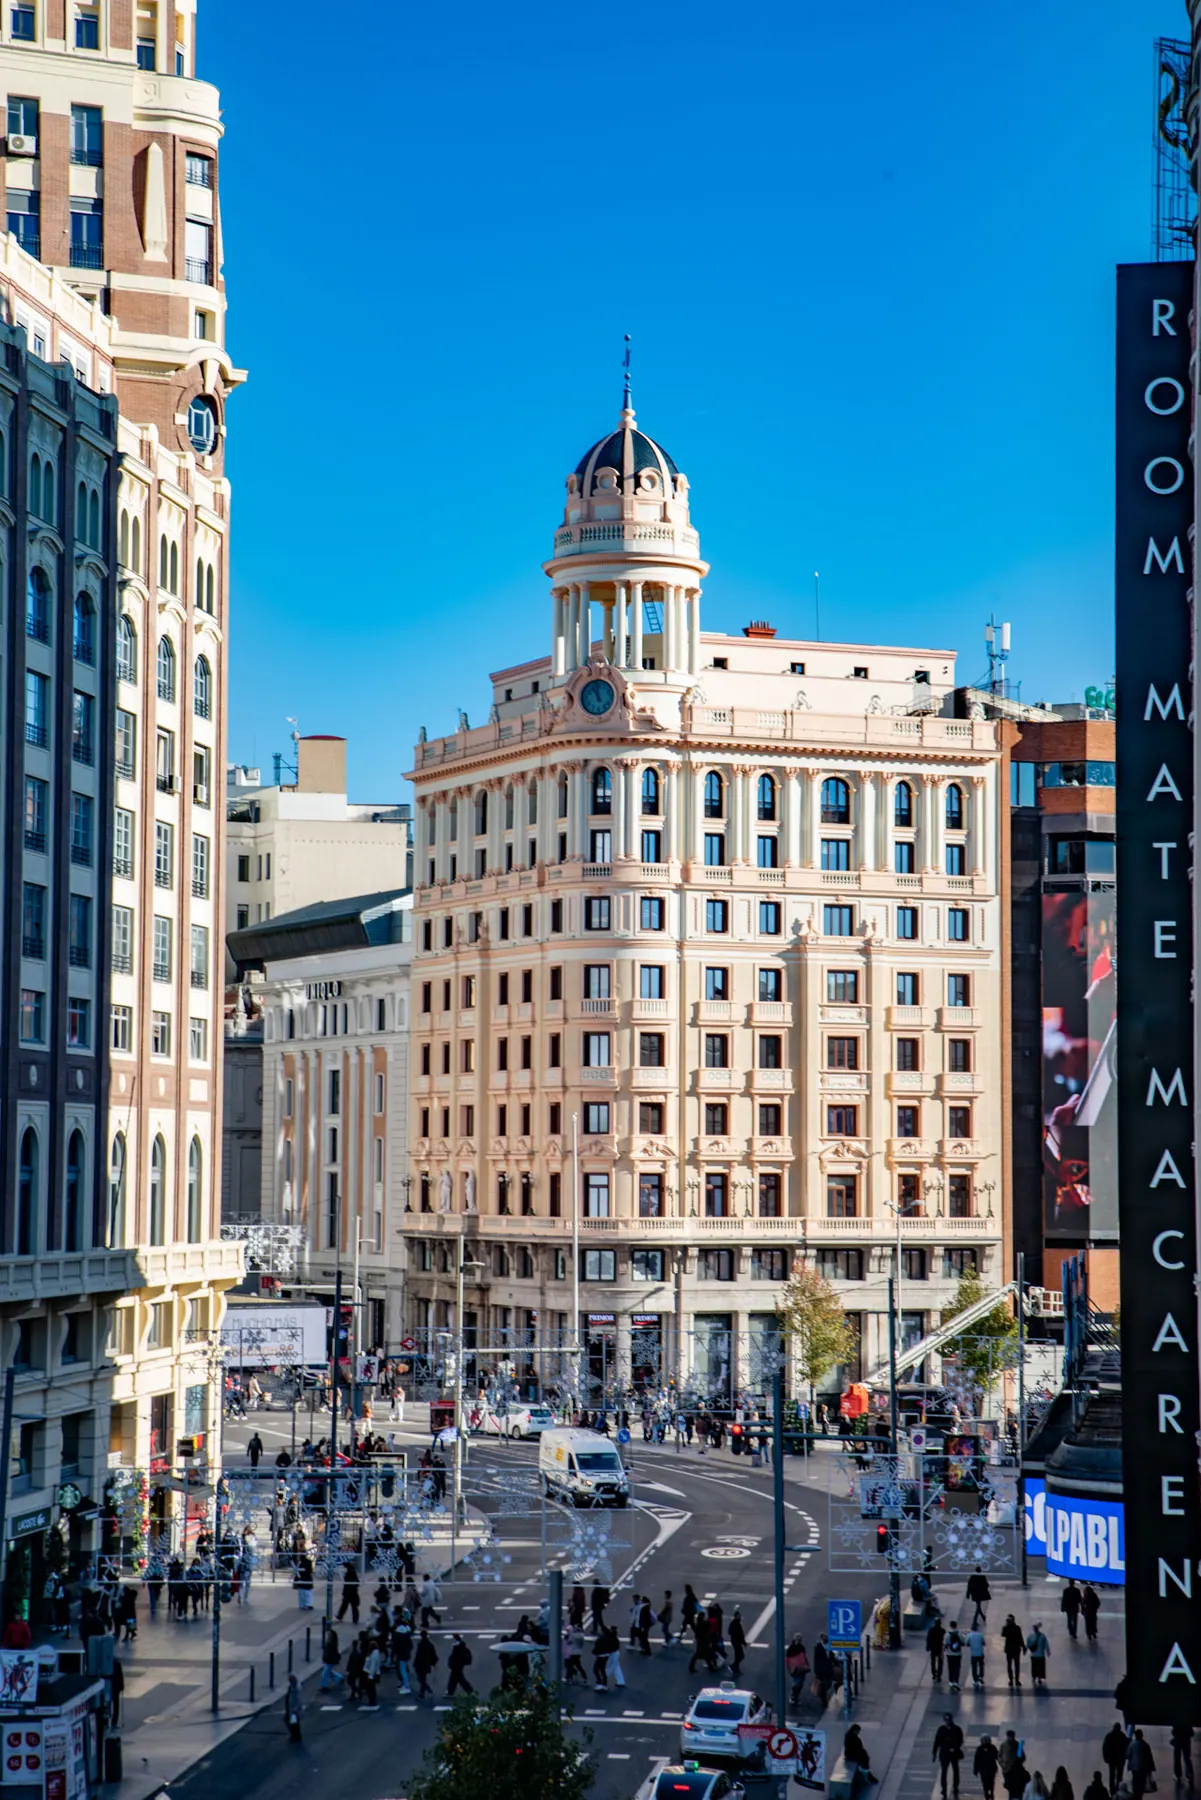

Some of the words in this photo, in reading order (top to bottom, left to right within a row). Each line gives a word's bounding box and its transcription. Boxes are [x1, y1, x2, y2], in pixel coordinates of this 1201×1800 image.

[1143, 298, 1185, 576] ROOM
[1143, 682, 1186, 960] MATE
[303, 980, 341, 1001] UNIQLO
[1146, 1066, 1195, 1684] MACARENA
[836, 1607, 855, 1635] P
